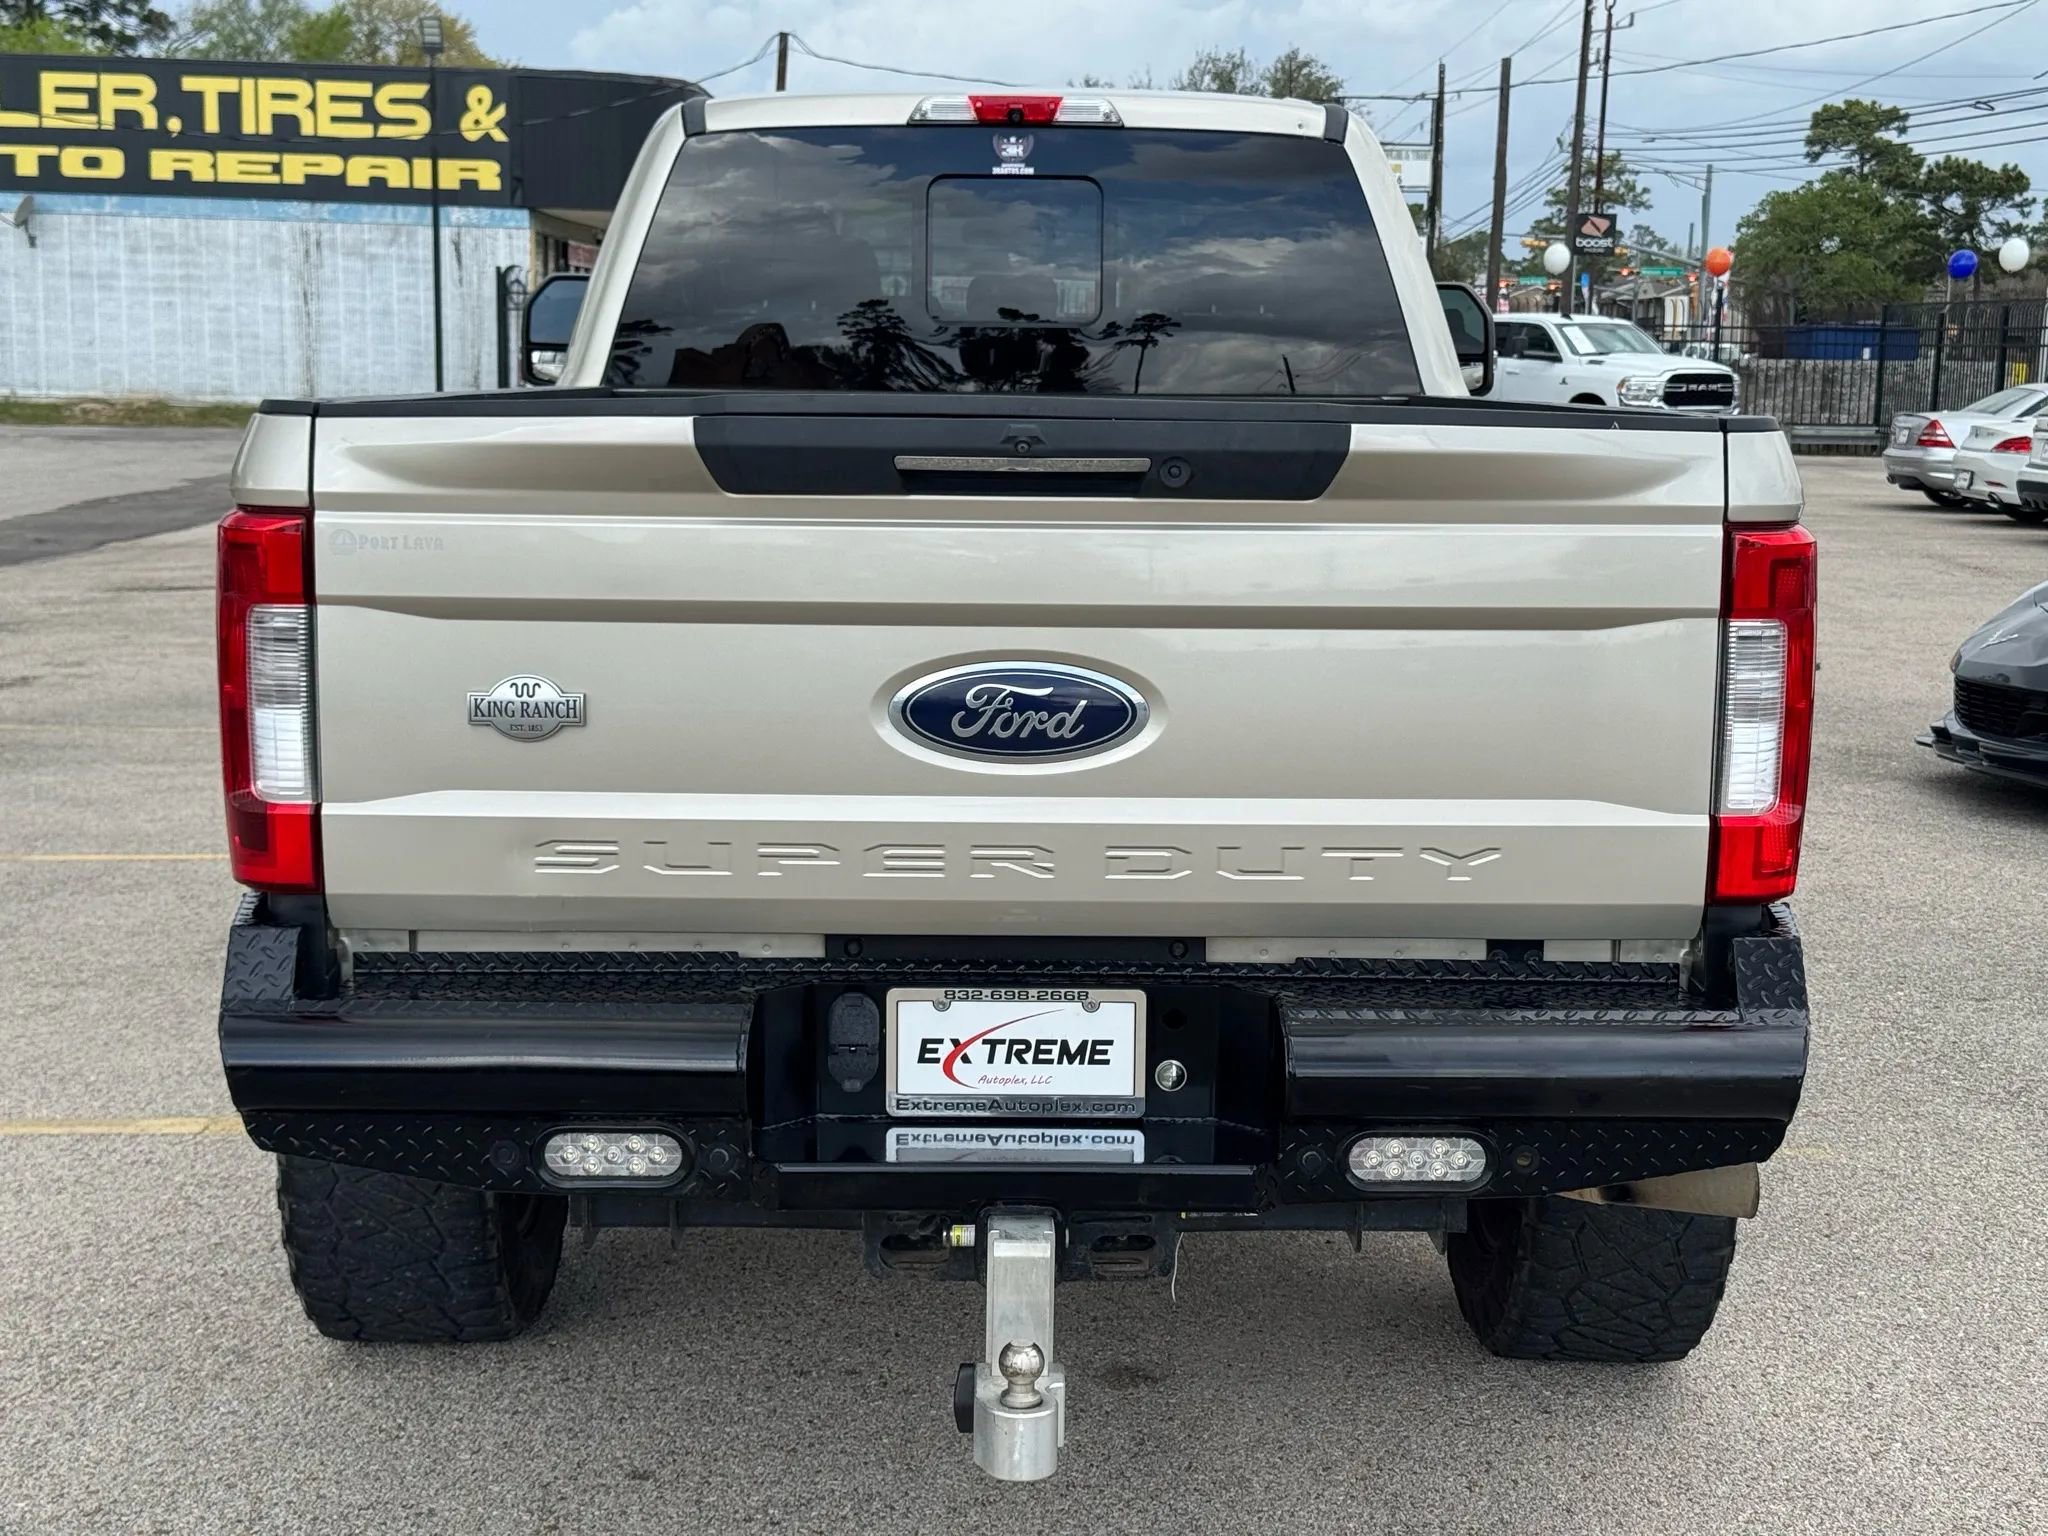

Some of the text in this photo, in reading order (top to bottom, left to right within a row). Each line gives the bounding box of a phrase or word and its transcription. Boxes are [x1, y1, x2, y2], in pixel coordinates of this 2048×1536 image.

[181, 75, 431, 142] TIRES
[459, 84, 509, 142] &
[149, 148, 501, 191] REPAIR
[1575, 237, 1613, 248] boost
[1687, 383, 1718, 392] RAM
[358, 534, 445, 551] PORT LAVA
[473, 698, 578, 718] KING RANCH
[951, 683, 1088, 738] Ford
[527, 724, 544, 732] 1853
[534, 839, 1502, 881] SUPER DUTY
[943, 989, 1090, 1001] 832-698-2668
[916, 1037, 1115, 1066] EXTREME
[977, 1074, 1054, 1086] Autoplex, LLC
[895, 1097, 1136, 1114] ExtremeAutoplex.com
